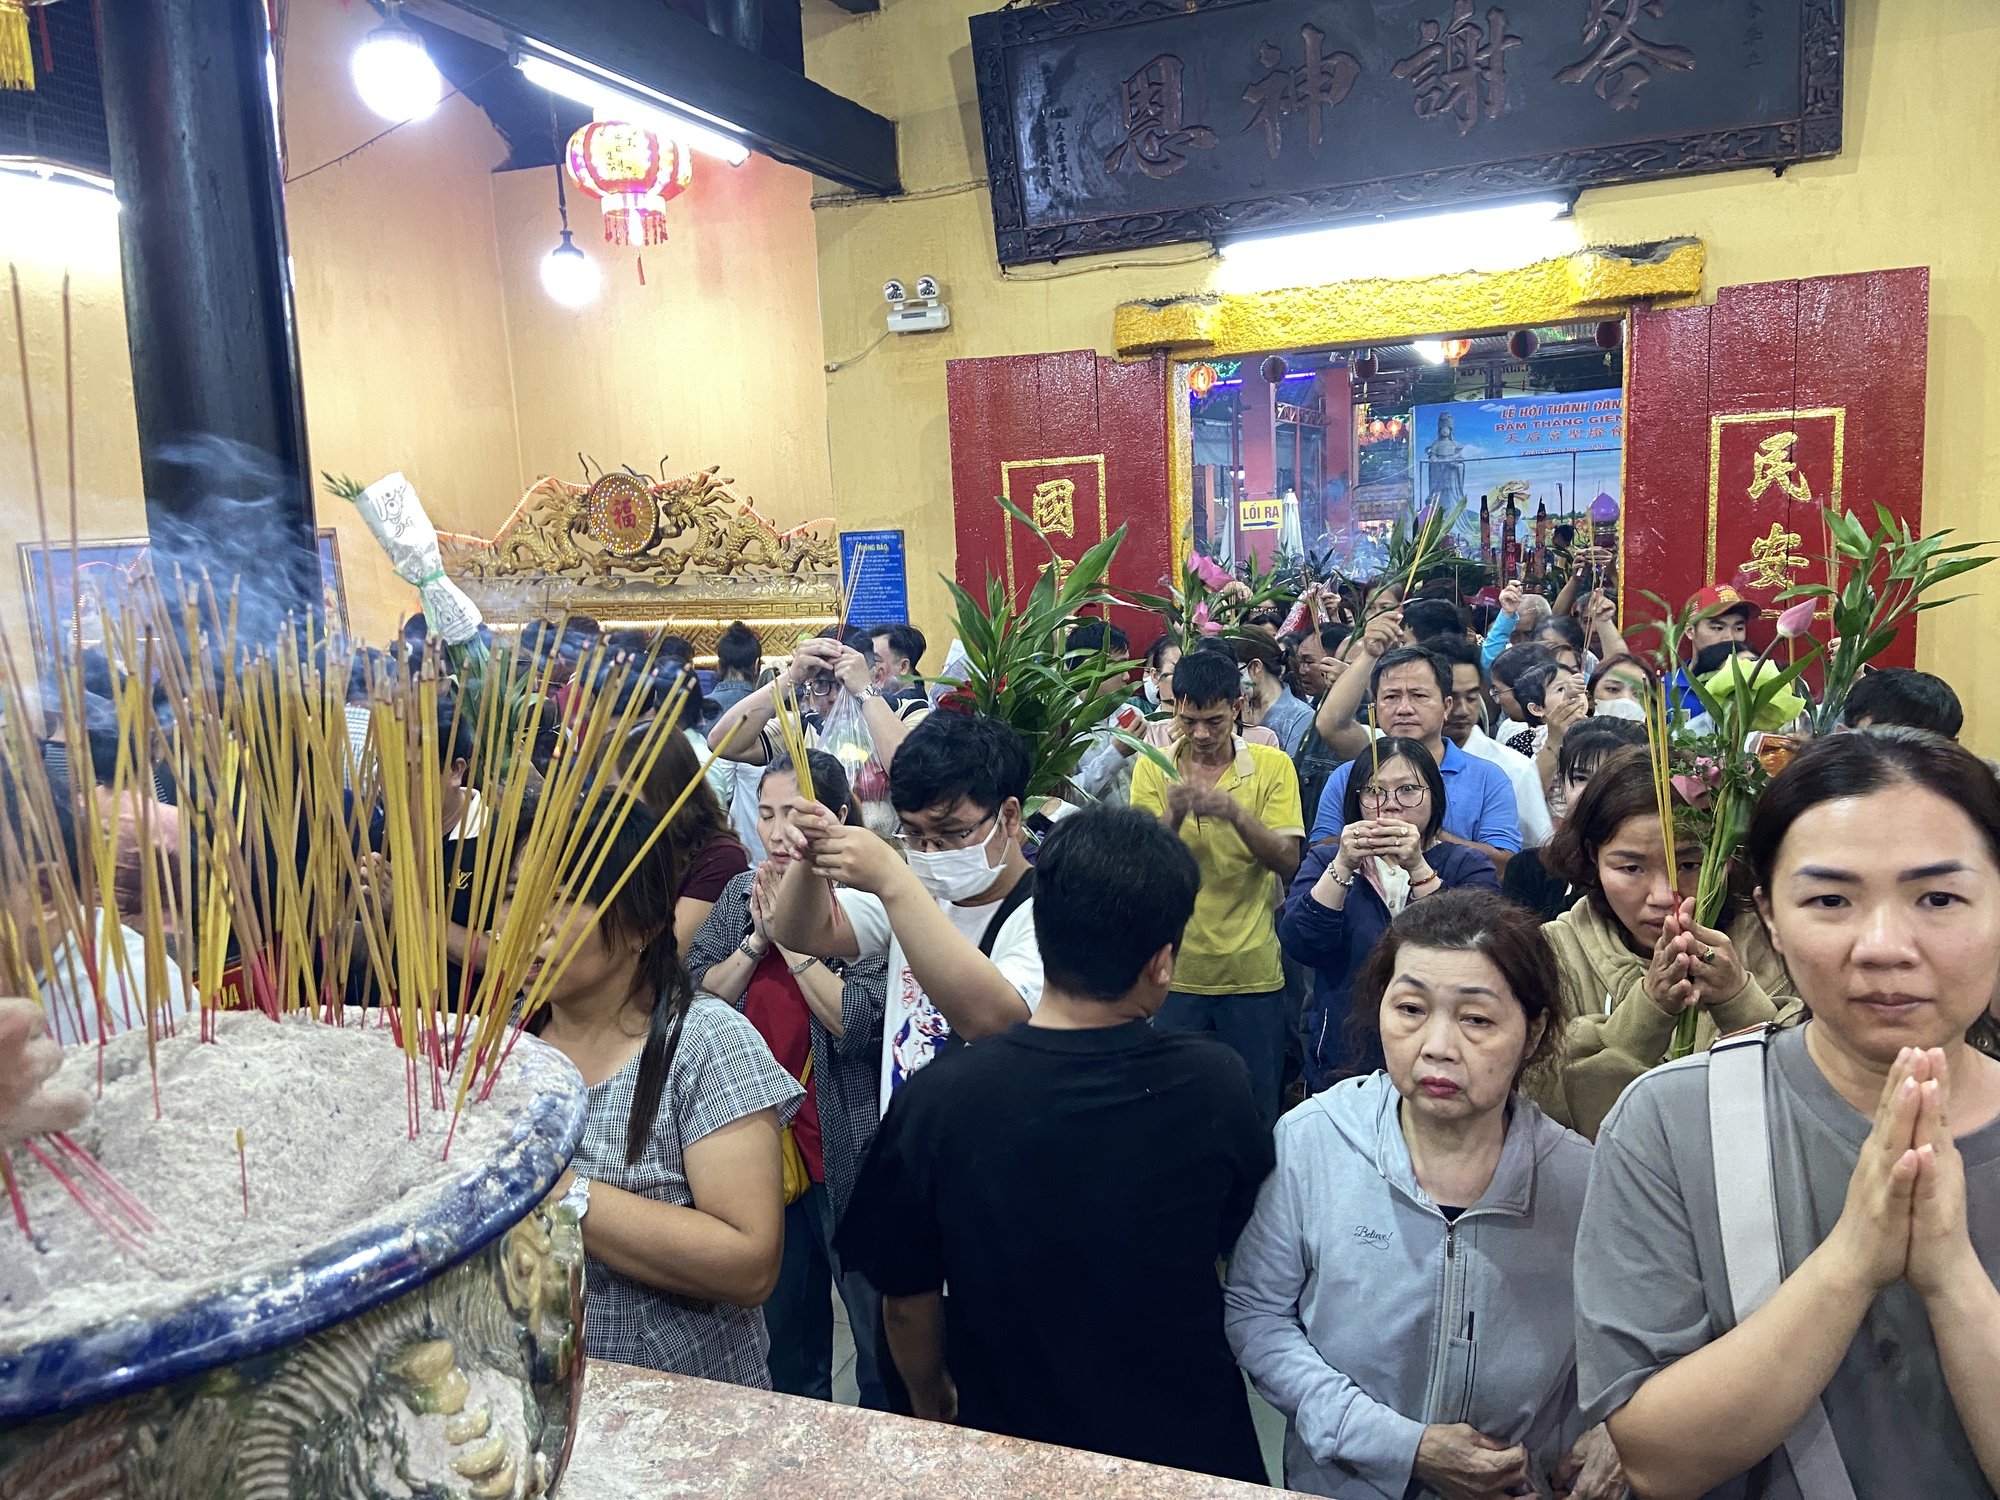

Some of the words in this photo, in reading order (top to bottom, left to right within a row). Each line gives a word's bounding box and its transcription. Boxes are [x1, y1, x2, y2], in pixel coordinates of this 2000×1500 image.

[1520, 404, 1542, 418] HỘI
[1547, 401, 1590, 415] THÁNH
[1593, 397, 1624, 411] ĐĂN
[1532, 416, 1583, 429] THÁNG
[610, 499, 637, 530] 福
[1242, 502, 1260, 520] LỐI
[1264, 505, 1280, 519] RA
[1740, 431, 1812, 589] 民安
